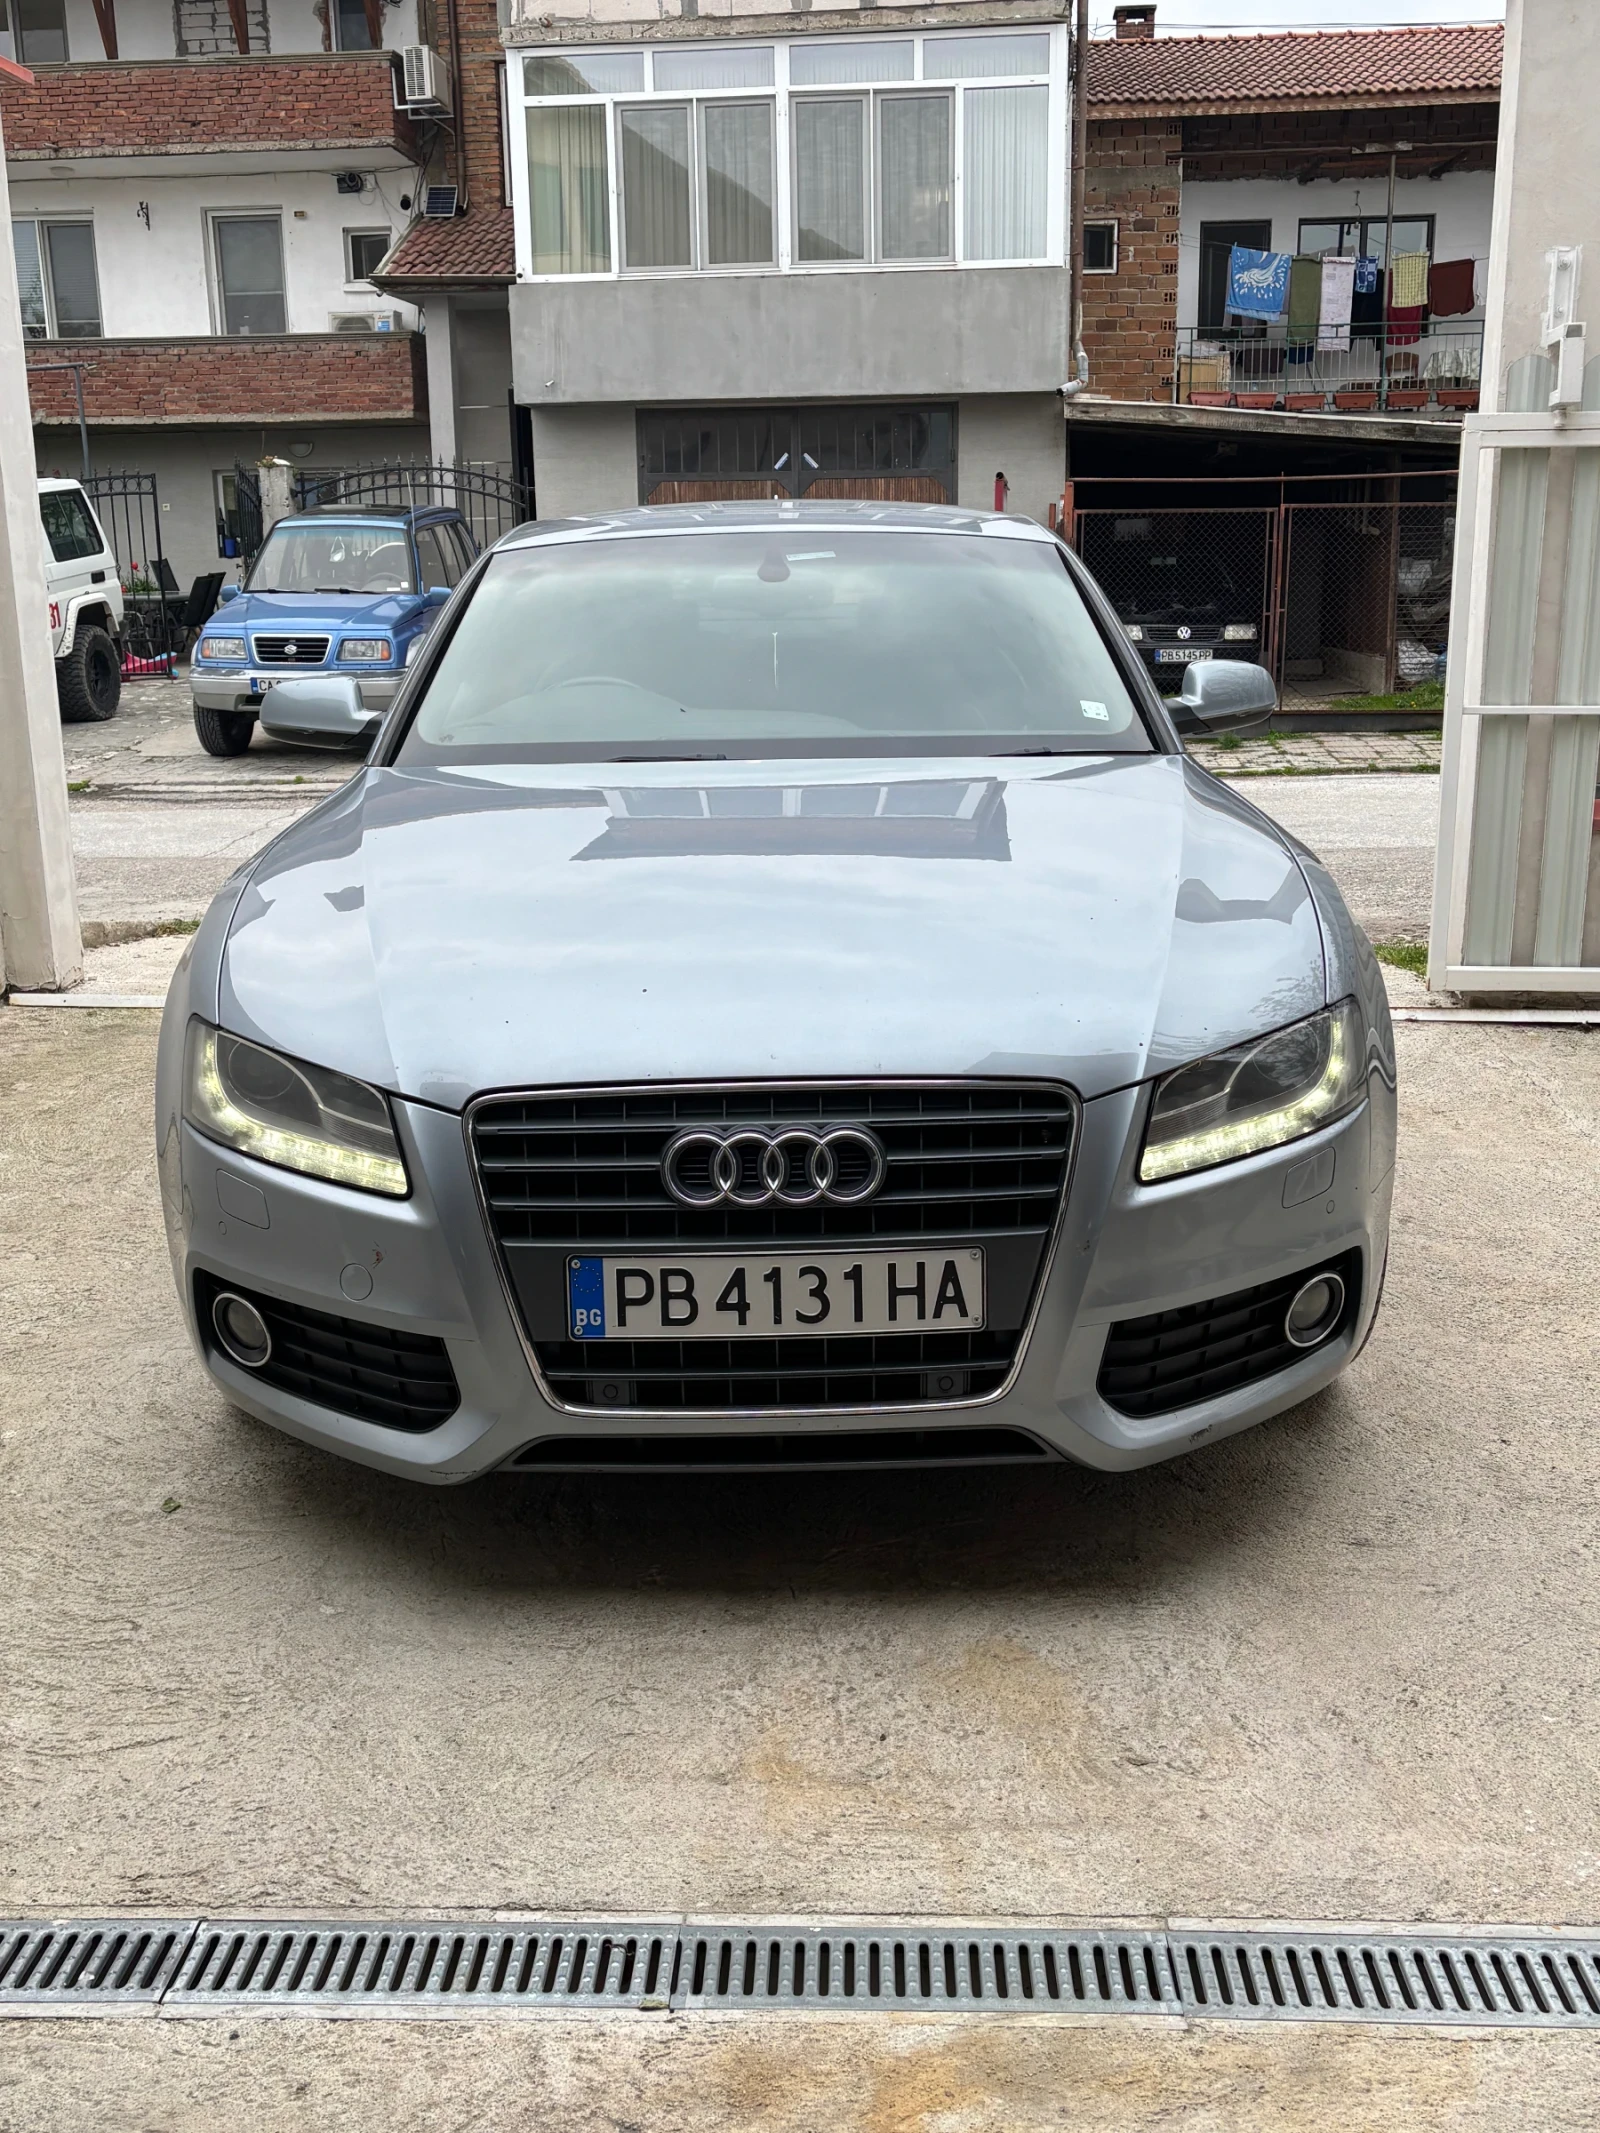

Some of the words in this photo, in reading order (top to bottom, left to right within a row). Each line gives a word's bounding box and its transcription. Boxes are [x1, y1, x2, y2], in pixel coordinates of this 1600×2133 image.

[1161, 650, 1174, 660] PB
[1175, 650, 1198, 660] 5145
[1199, 650, 1211, 660] PP
[259, 680, 273, 692] CA
[615, 1267, 699, 1327] PB
[715, 1264, 863, 1326] 4131
[887, 1259, 969, 1322] HA
[575, 1308, 602, 1326] BG
